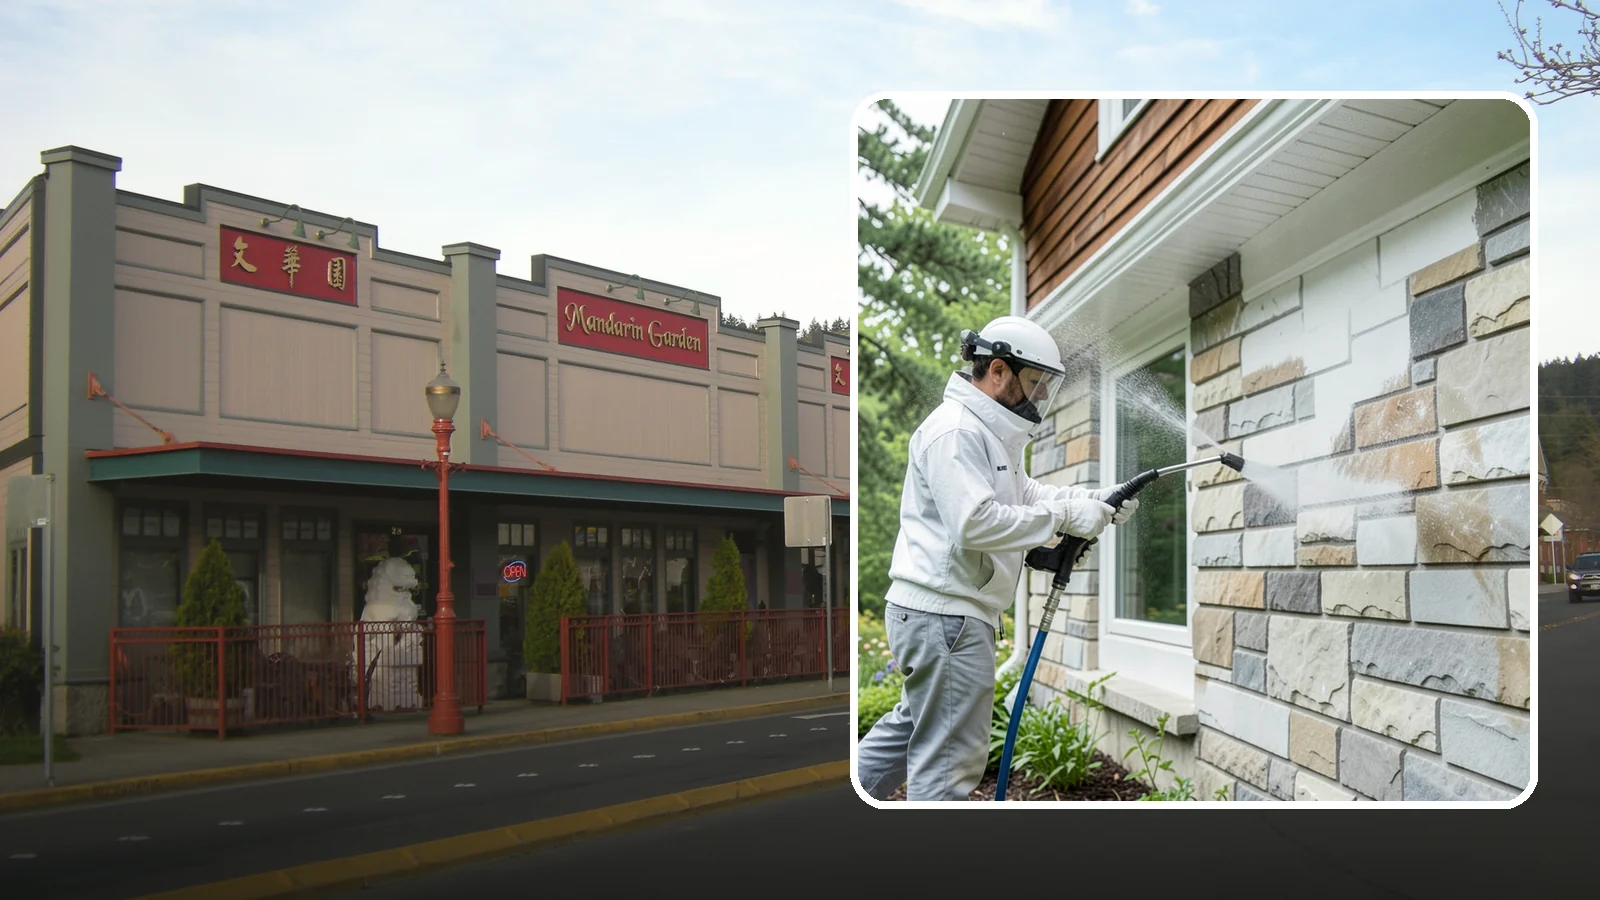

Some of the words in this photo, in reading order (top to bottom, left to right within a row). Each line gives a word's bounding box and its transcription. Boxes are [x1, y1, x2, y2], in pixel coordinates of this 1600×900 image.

[231, 235, 346, 291] 文華園
[564, 302, 643, 341] Mandarin
[648, 320, 701, 352] Garden
[834, 362, 846, 386] 文
[503, 565, 527, 578] OPEN
